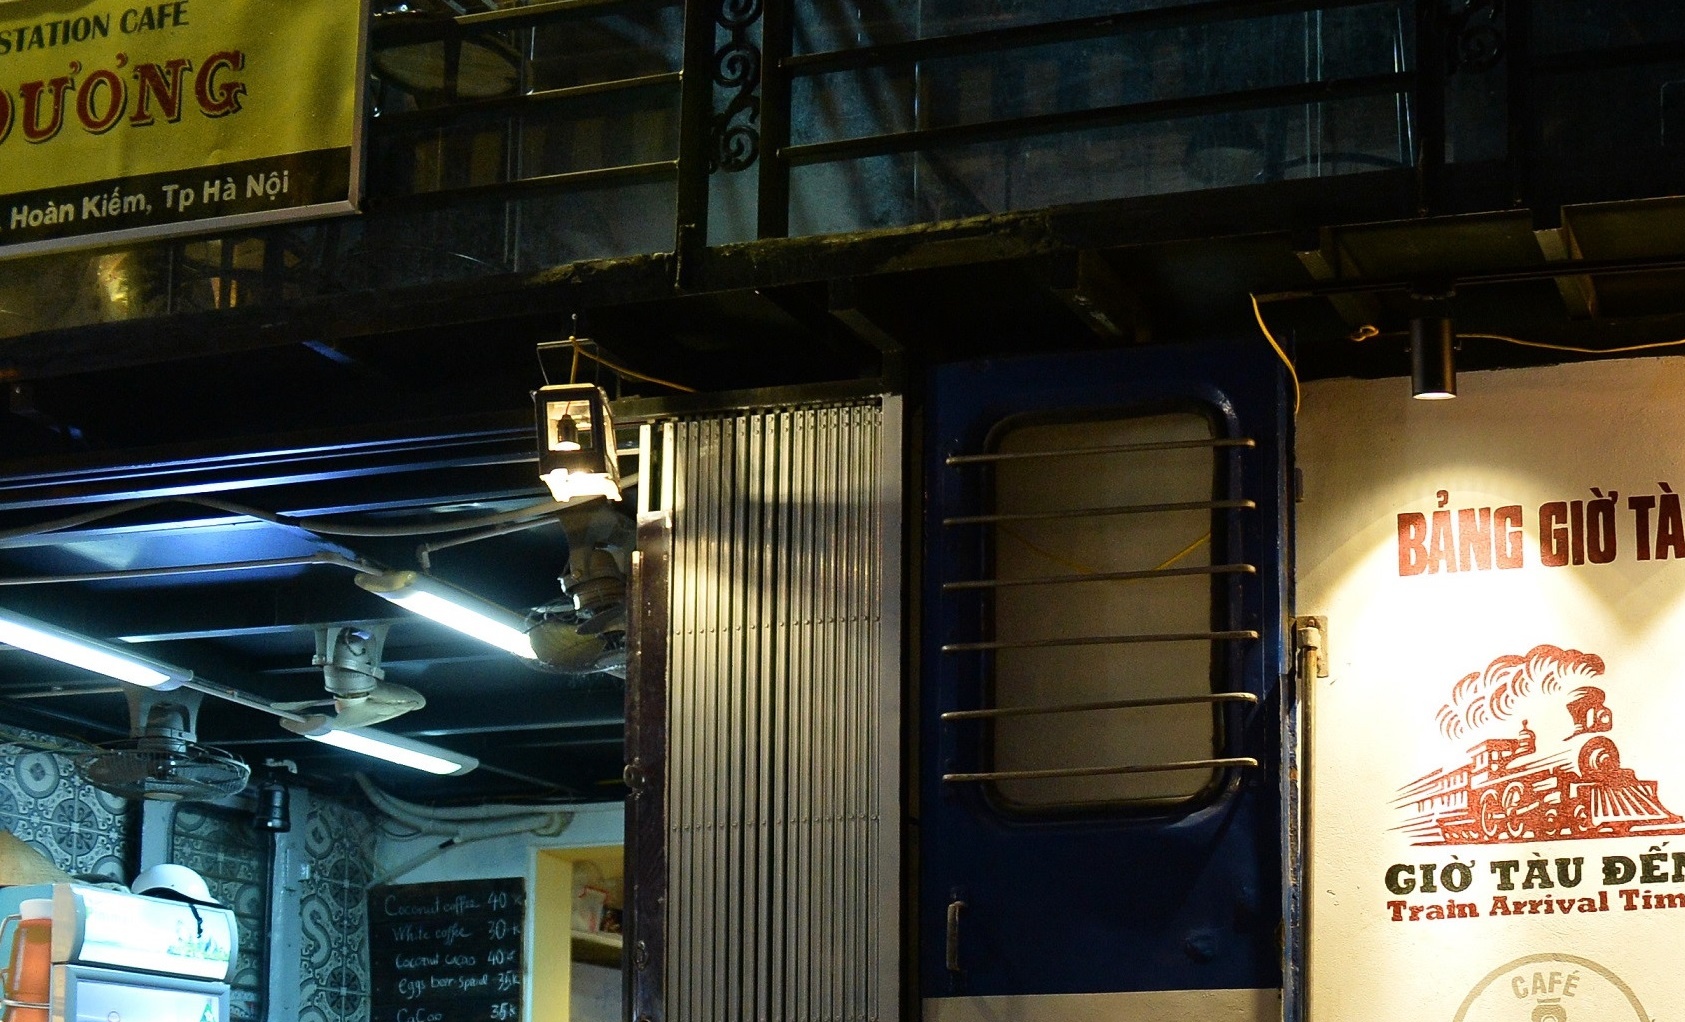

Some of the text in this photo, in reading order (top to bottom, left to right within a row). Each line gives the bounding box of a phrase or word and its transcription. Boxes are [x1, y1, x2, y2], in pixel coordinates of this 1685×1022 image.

[0, 14, 110, 56] STATION
[10, 169, 289, 230] Hoàn Kiếm, Tp Hà Nội
[1397, 489, 1524, 577] BẢNG
[1538, 487, 1620, 567] GIỜ
[1384, 855, 1476, 895] GIỜ
[1490, 851, 1584, 891] TÀU
[1387, 899, 1479, 922] Train
[1489, 890, 1609, 917] Arrival
[1511, 970, 1581, 1000] CAFÉ
